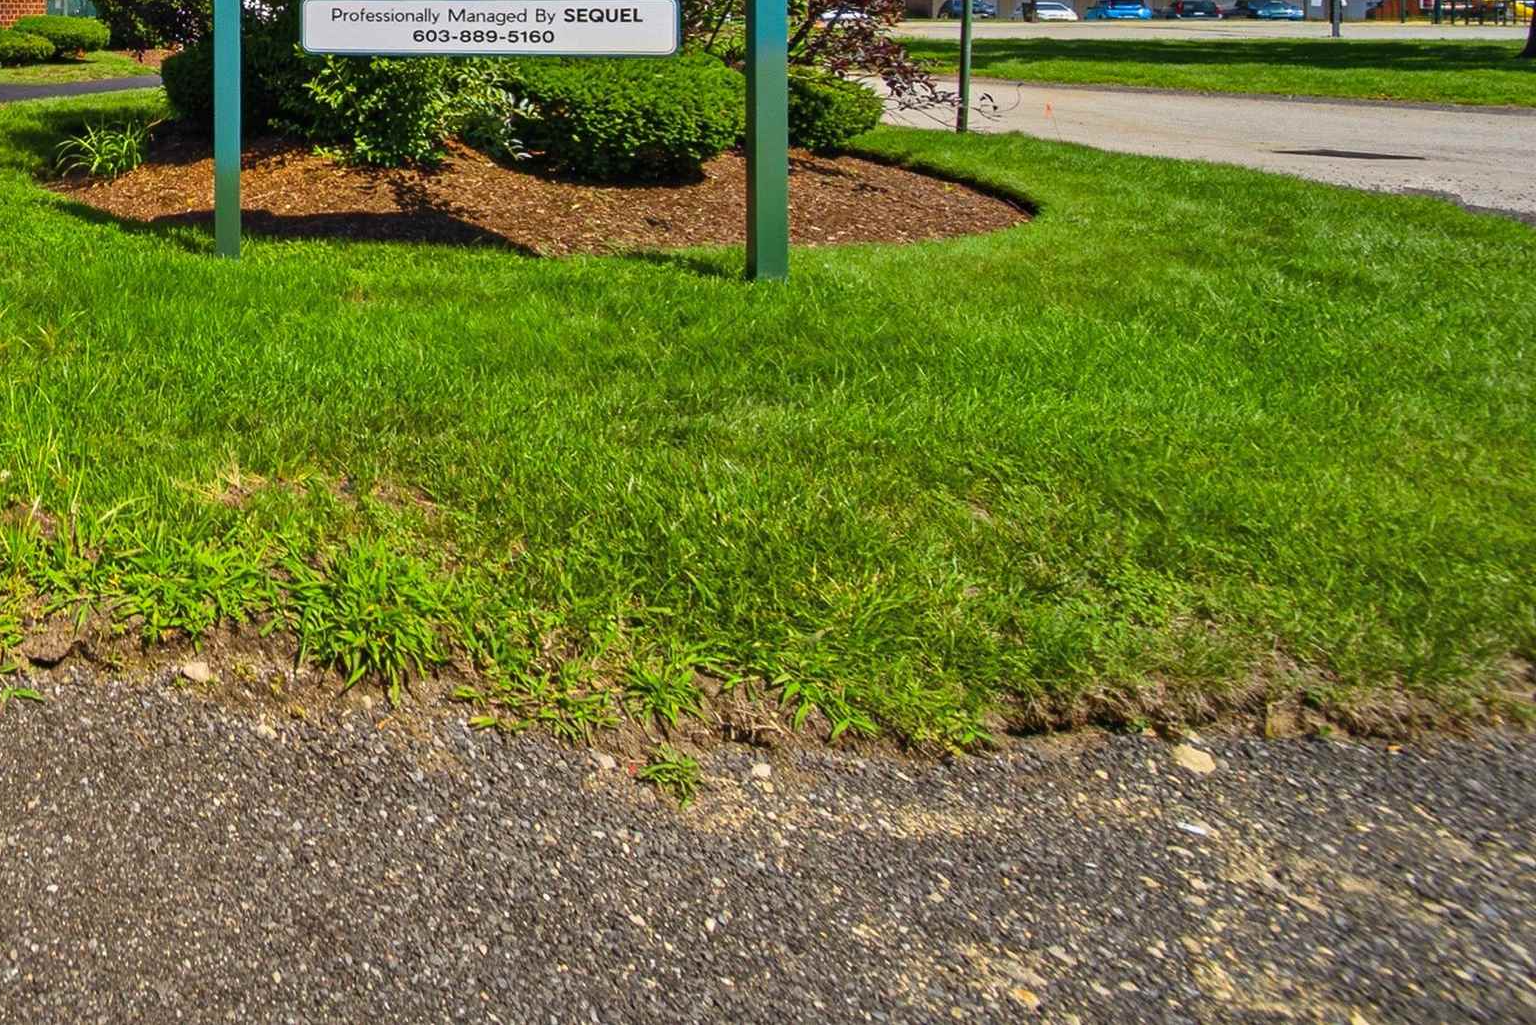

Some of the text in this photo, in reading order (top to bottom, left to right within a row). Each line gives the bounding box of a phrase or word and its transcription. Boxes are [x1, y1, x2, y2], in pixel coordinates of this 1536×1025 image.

[331, 7, 643, 25] Professionally Managed By SEQUEL
[412, 29, 555, 44] 603-889-5160
